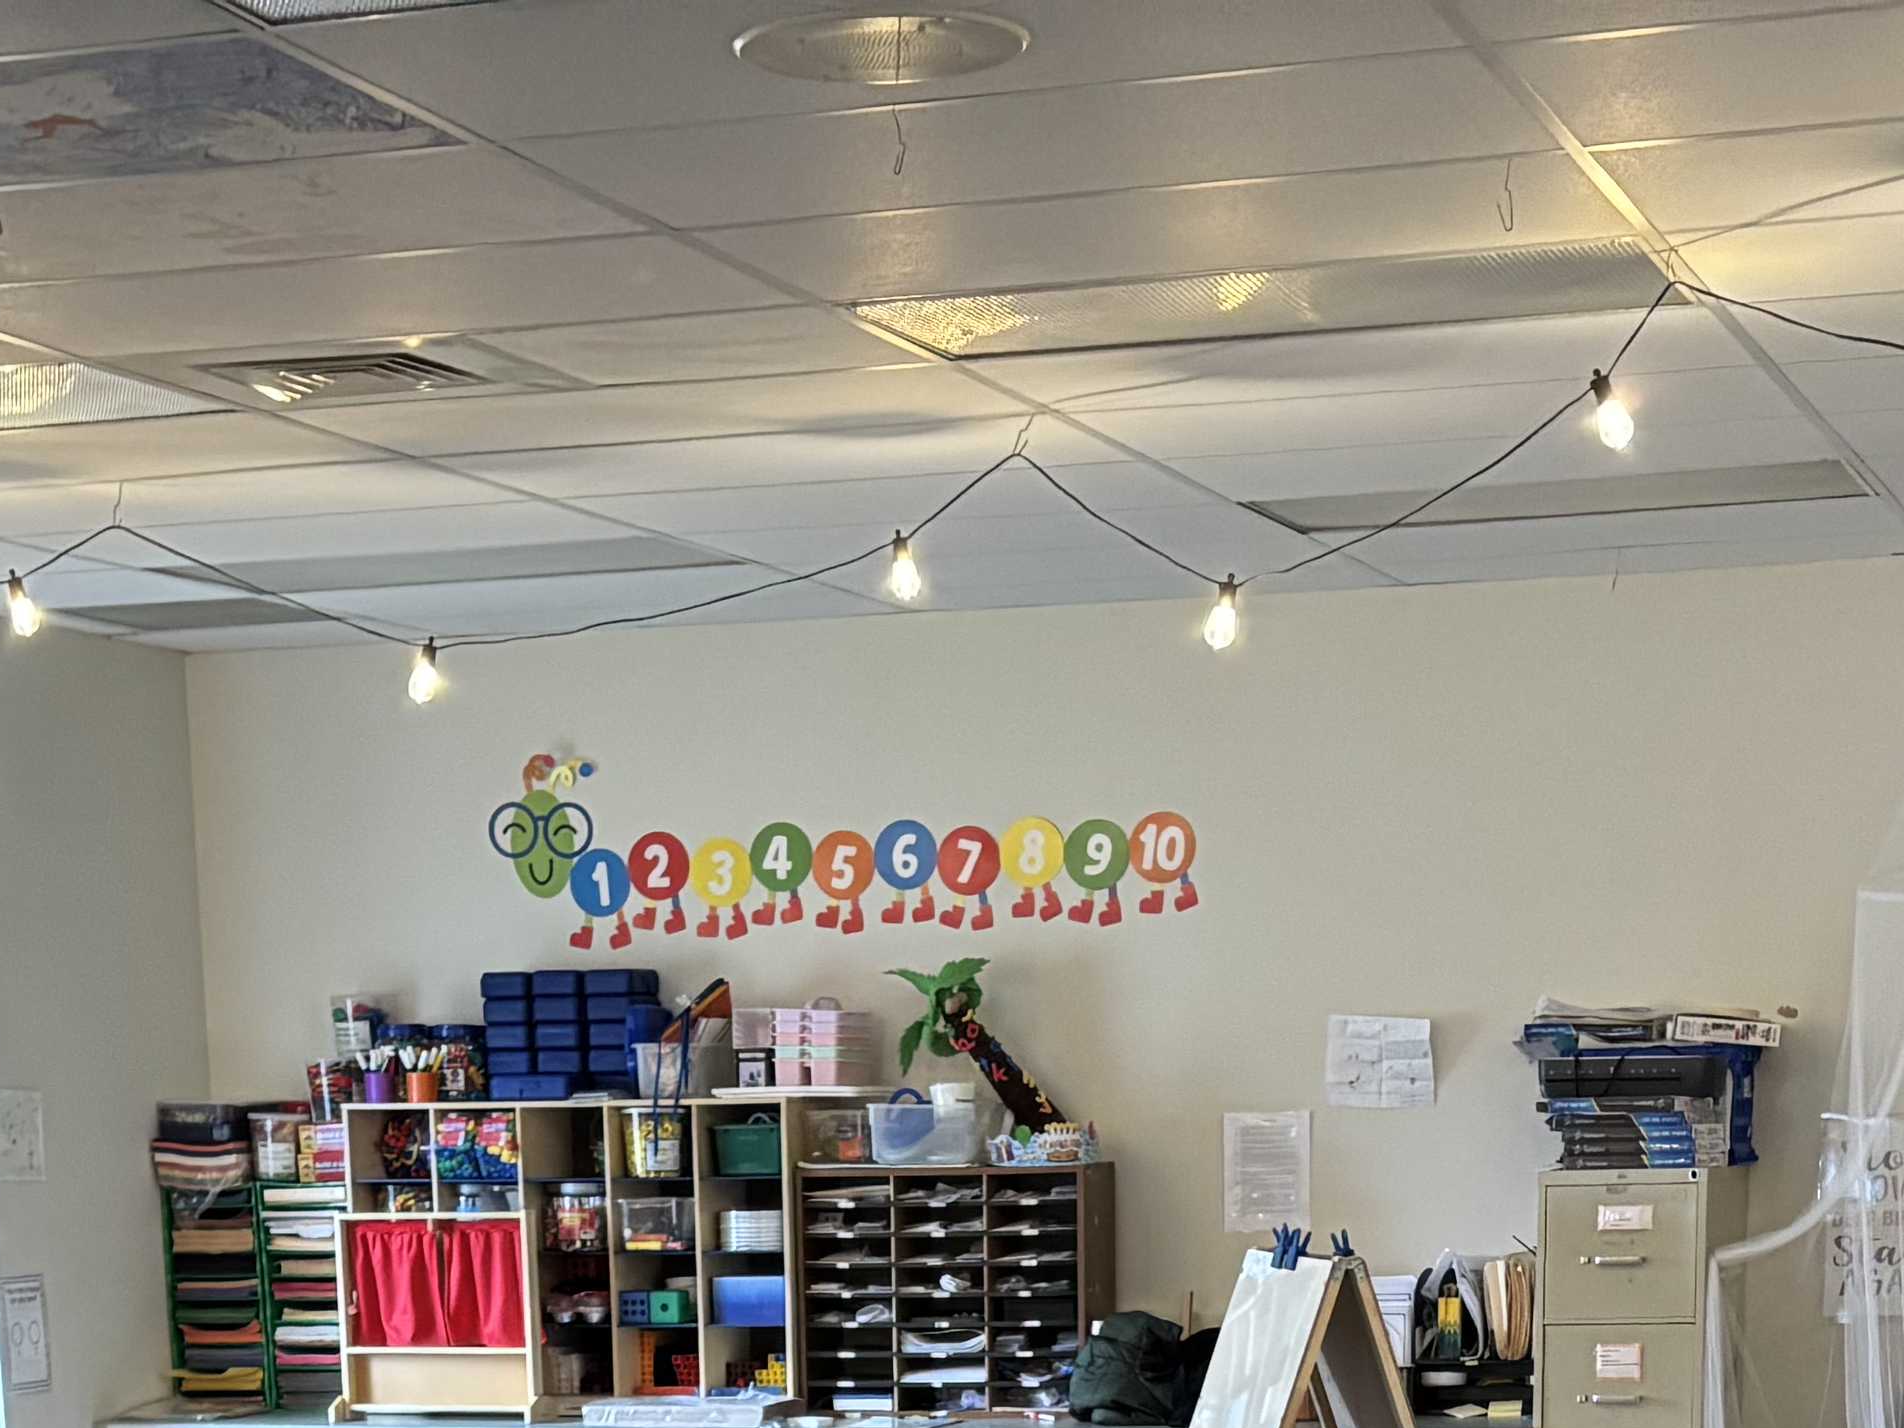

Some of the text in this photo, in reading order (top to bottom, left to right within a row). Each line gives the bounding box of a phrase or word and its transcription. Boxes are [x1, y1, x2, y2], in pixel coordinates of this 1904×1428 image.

[592, 824, 1186, 905] 1 2 3 4 5 6 7 8 9 10
